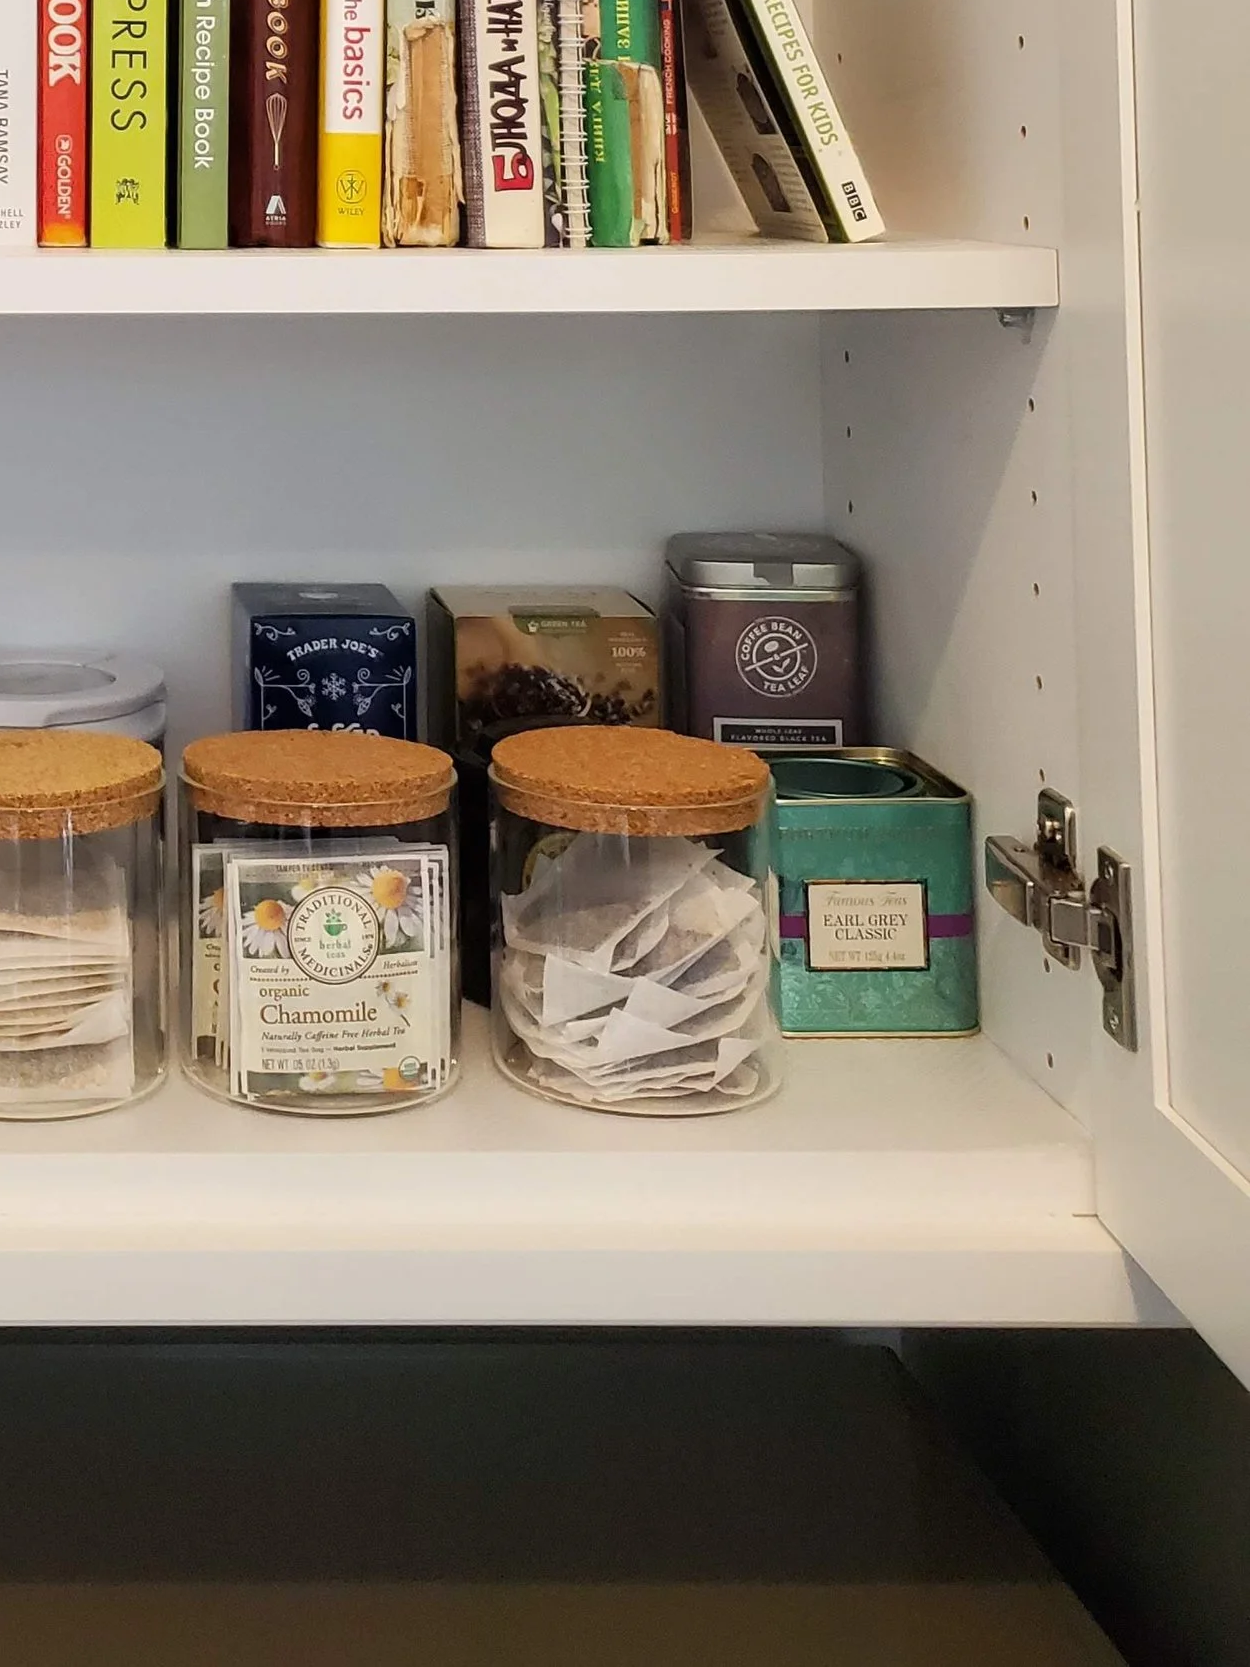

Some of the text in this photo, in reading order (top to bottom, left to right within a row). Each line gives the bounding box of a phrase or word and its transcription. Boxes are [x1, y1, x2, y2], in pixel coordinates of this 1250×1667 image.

[662, 18, 672, 64] COOKING
[191, 16, 216, 100] Recipe
[342, 27, 371, 121] basics
[665, 65, 674, 105] FRENCH
[792, 64, 816, 101] FOR
[807, 98, 839, 147] KIDS
[194, 108, 214, 170] Book
[488, 54, 534, 192] БЛЮДА
[593, 100, 606, 163] КНИГА
[57, 155, 72, 215] GOLDEN
[841, 180, 868, 223] BBC
[287, 637, 338, 661] TRADER
[611, 646, 647, 658] 100%
[740, 621, 802, 661] COFFEE BEAN
[763, 664, 809, 693] TEA LEAF
[296, 894, 374, 932] TRADITIONAL
[823, 913, 909, 927] EARL GREY
[319, 939, 352, 950] herbal
[834, 927, 898, 941] CLASSIC
[250, 965, 290, 975] Created by
[297, 945, 372, 978] MEDICINALS
[326, 951, 346, 959] teas
[259, 984, 310, 1001] organic
[260, 1001, 378, 1026] Chamomile
[262, 1026, 406, 1042] Naturally Caffeine Free Herbal Tea
[262, 1059, 275, 1071] NET
